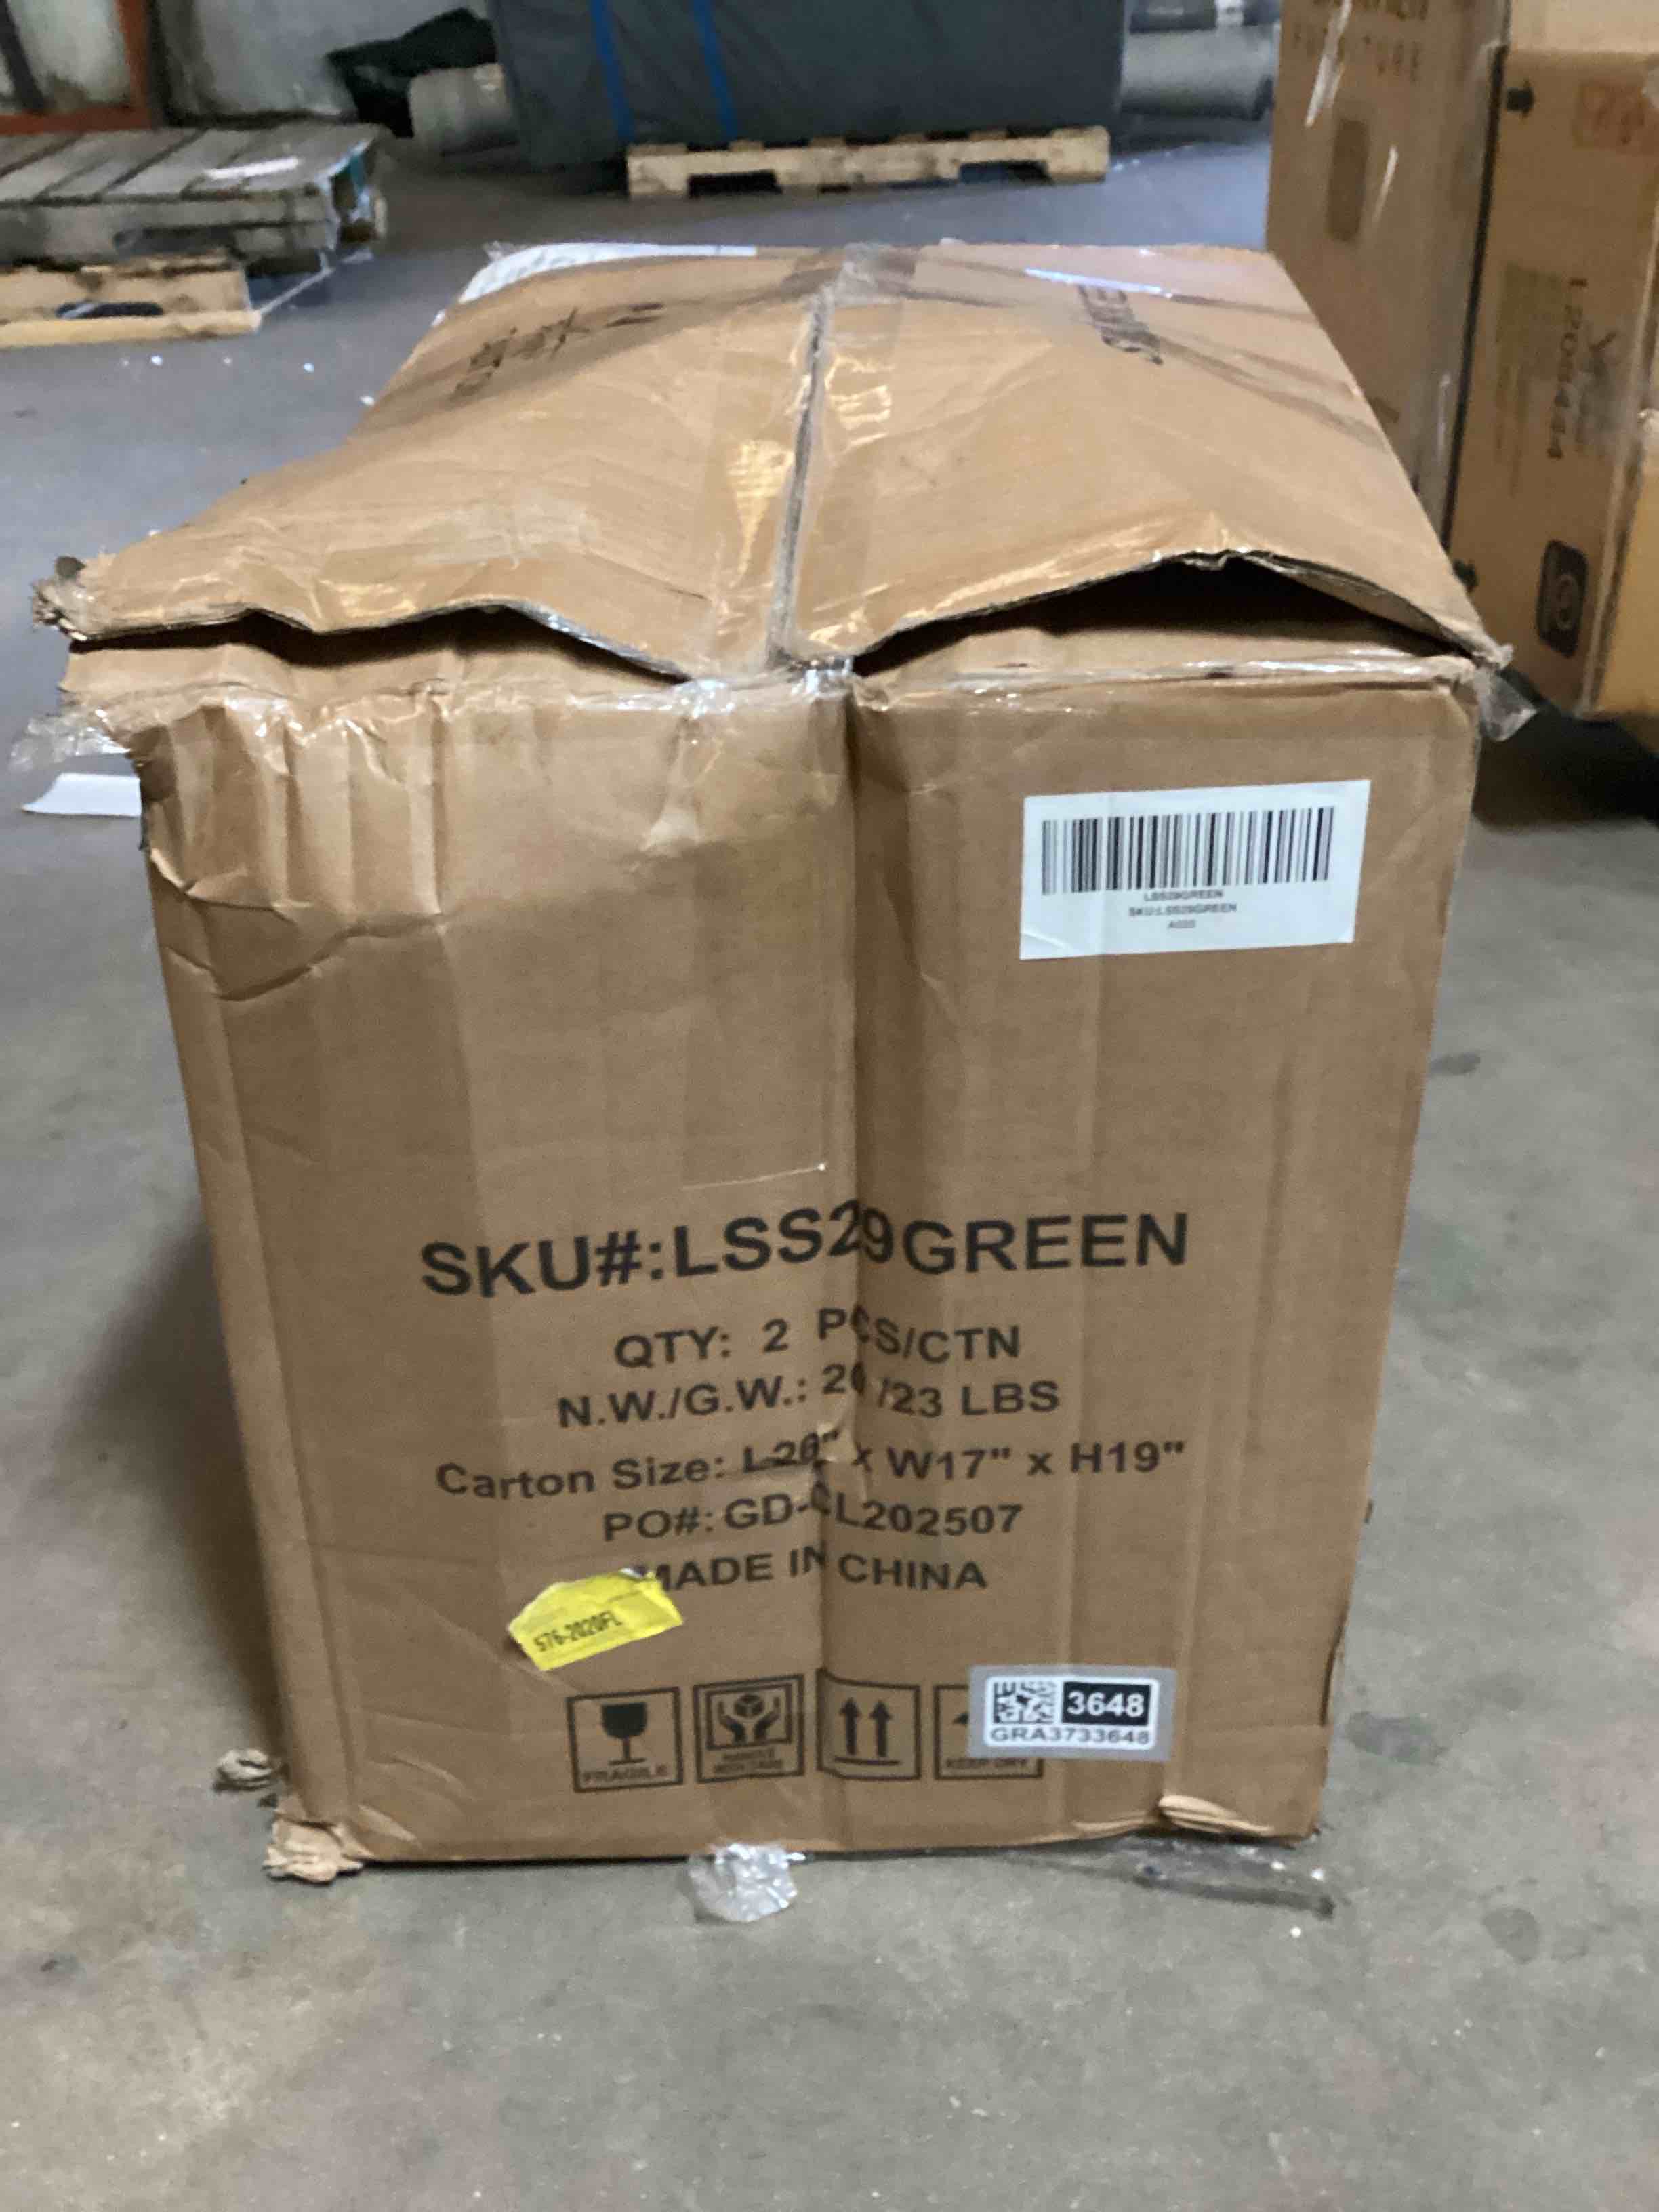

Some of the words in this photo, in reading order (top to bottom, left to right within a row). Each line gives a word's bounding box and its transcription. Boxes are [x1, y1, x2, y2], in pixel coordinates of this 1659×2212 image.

[420, 1199, 1188, 1298] SKU#:LSS29GREEN
[614, 1326, 729, 1368] QTY:
[763, 1319, 789, 1353] 2
[558, 1375, 806, 1427] N.W./G.W.:
[961, 1380, 1059, 1415] LBS
[436, 1464, 594, 1499] Carton
[613, 1457, 724, 1489] Size:
[853, 1443, 872, 1472] x
[888, 1447, 1010, 1479] W17"
[1027, 1452, 1053, 1475] x
[1071, 1441, 1185, 1473] H19"
[605, 1508, 712, 1540] PO#:
[790, 1542, 826, 1577] IN
[838, 1553, 987, 1590] CHINA
[1067, 1692, 1144, 1717] 3648
[990, 1727, 1149, 1744] GRA3733648
